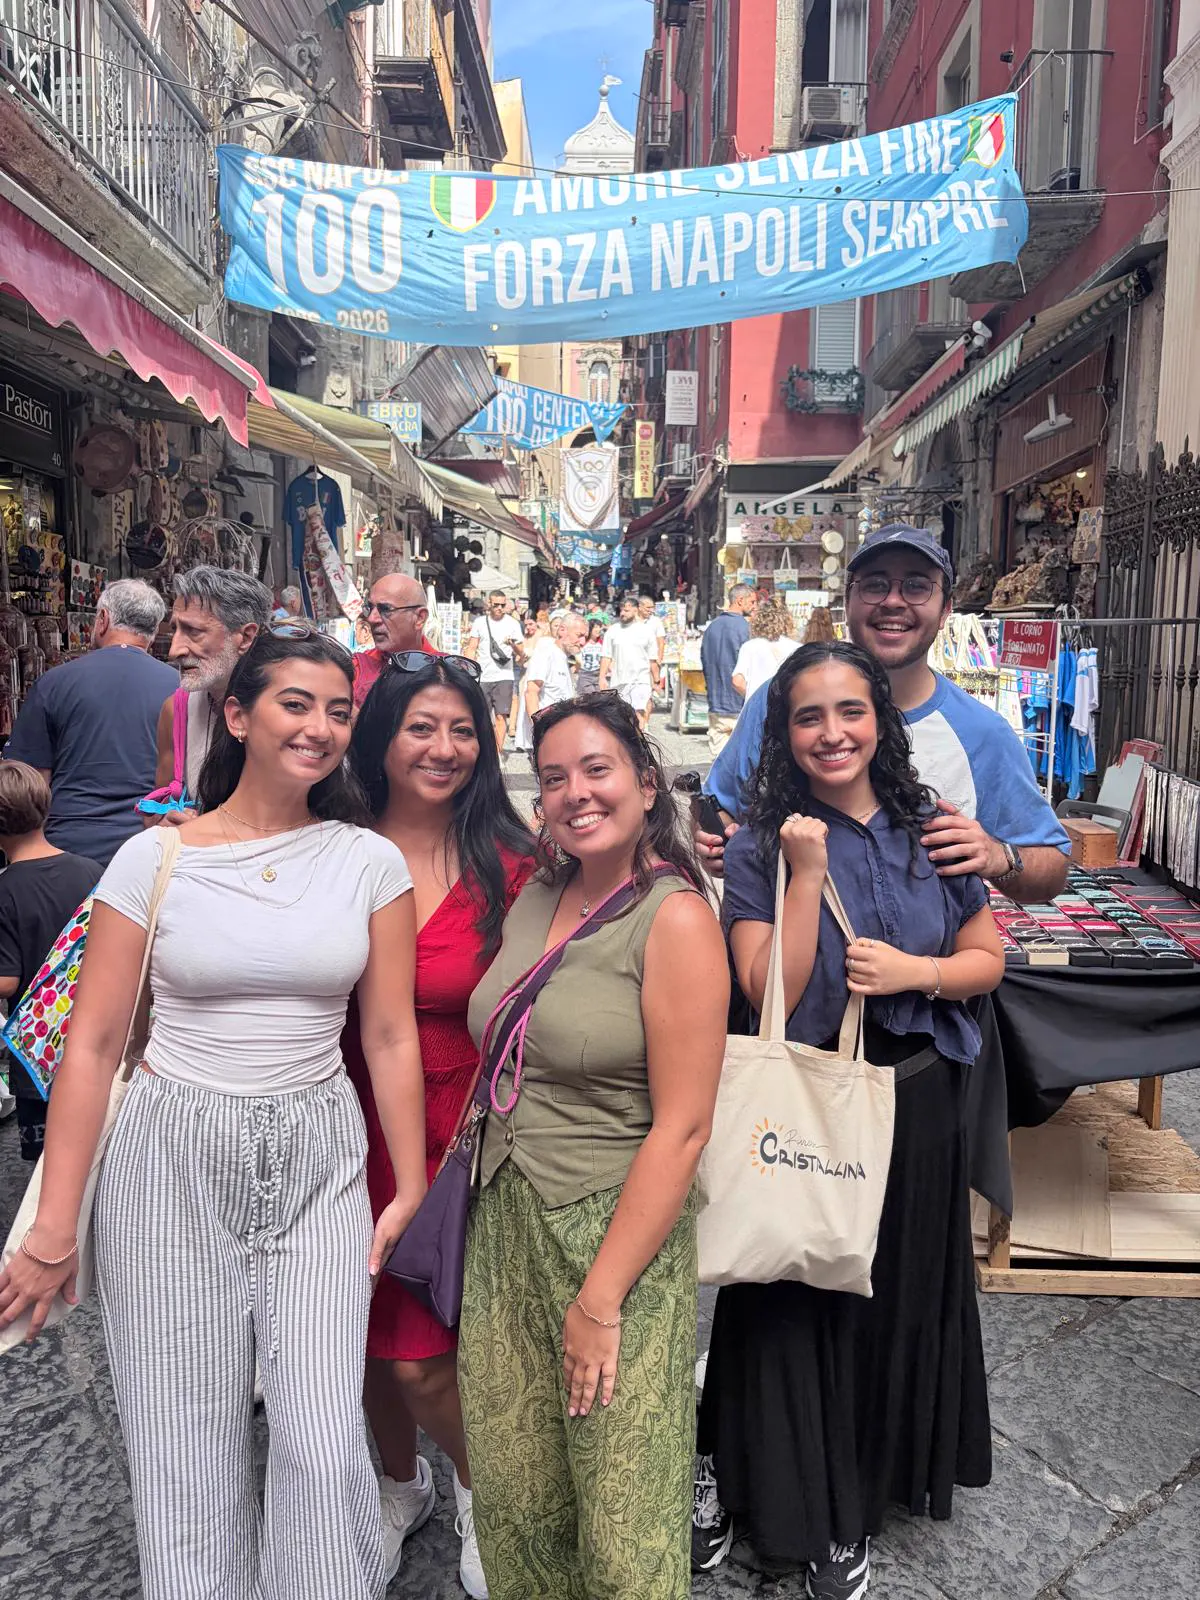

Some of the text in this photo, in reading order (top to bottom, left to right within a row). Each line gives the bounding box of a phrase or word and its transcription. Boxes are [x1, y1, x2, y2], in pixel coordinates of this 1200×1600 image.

[512, 167, 700, 216] AMORE
[878, 119, 962, 175] FINE
[252, 188, 402, 295] 100
[463, 177, 1009, 312] FORZA NAPOLI SEMPRE
[336, 309, 389, 334] 2026
[5, 383, 52, 430] Pastori
[52, 452, 62, 467] 40
[734, 501, 843, 516] ANGELA
[1020, 623, 1043, 637] CORNO
[759, 1131, 867, 1181] CRISTALLINA
